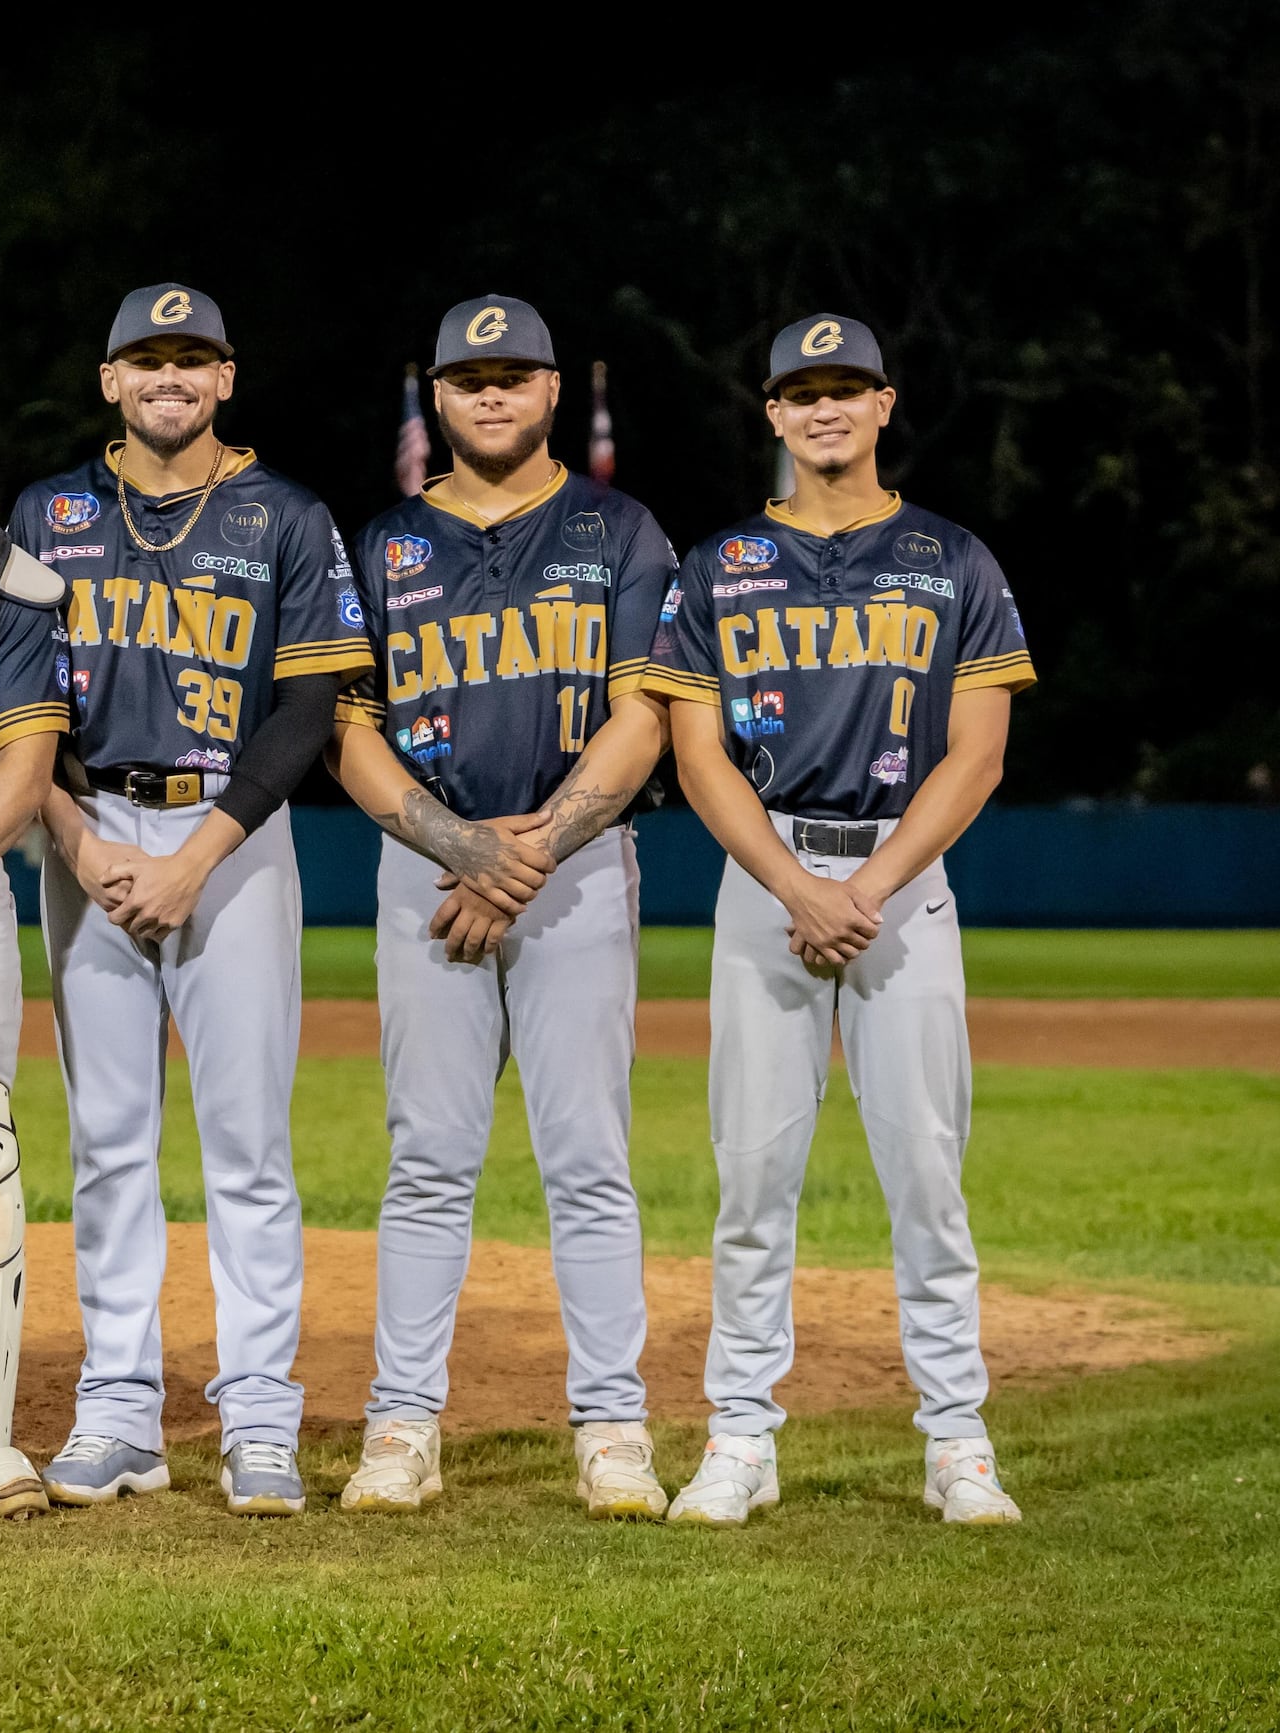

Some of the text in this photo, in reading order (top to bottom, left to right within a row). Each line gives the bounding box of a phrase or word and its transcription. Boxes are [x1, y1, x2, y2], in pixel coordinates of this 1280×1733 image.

[40, 548, 102, 561] EONO
[345, 603, 364, 623] Q
[387, 589, 440, 607] CONO
[713, 581, 785, 594] ECONO
[66, 574, 258, 671] ATAÑO
[387, 583, 608, 706] CATAÑO
[718, 588, 941, 679] CATAÑO
[176, 668, 244, 743] 39
[557, 685, 590, 753] 11
[888, 676, 917, 739] 0
[176, 780, 189, 795] 9
